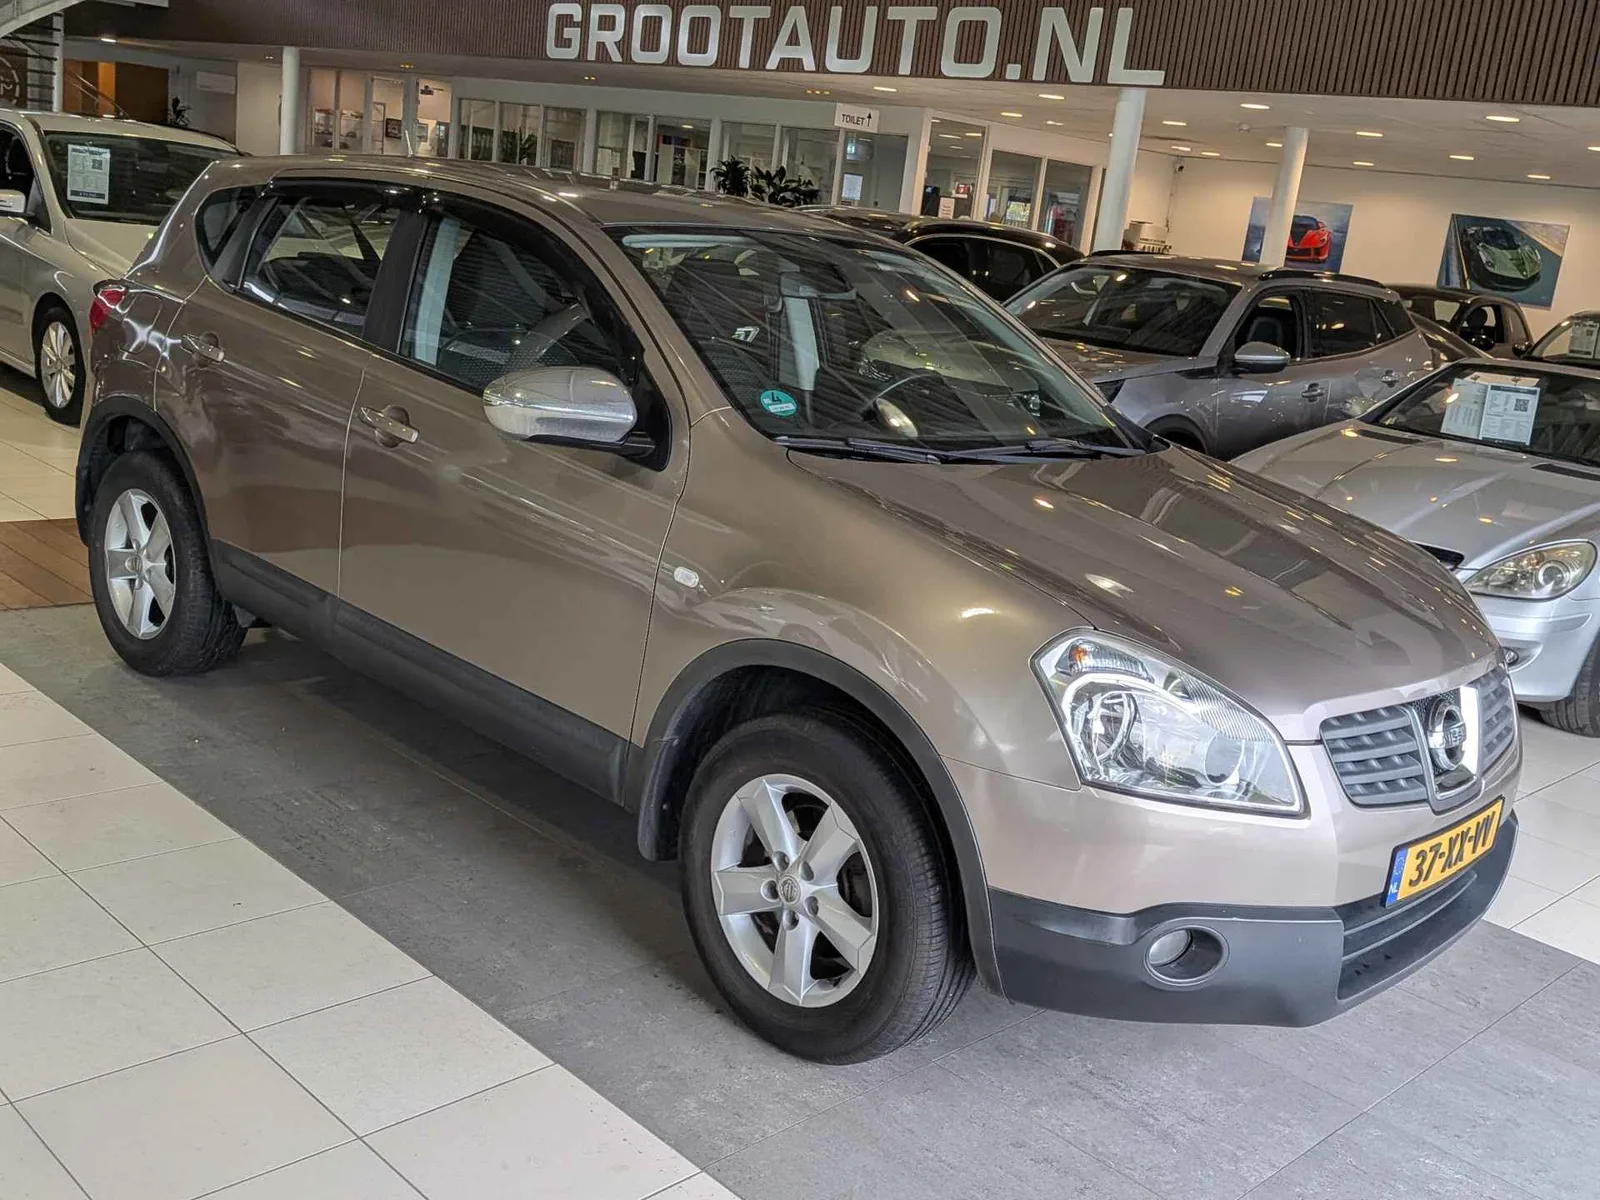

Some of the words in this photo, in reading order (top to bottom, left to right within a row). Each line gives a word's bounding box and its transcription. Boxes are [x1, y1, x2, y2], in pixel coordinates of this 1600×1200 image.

[545, 3, 1165, 86] GROOTAUTO.NL
[841, 113, 866, 126] TOILET
[1408, 811, 1496, 887] 37-XX-VV
